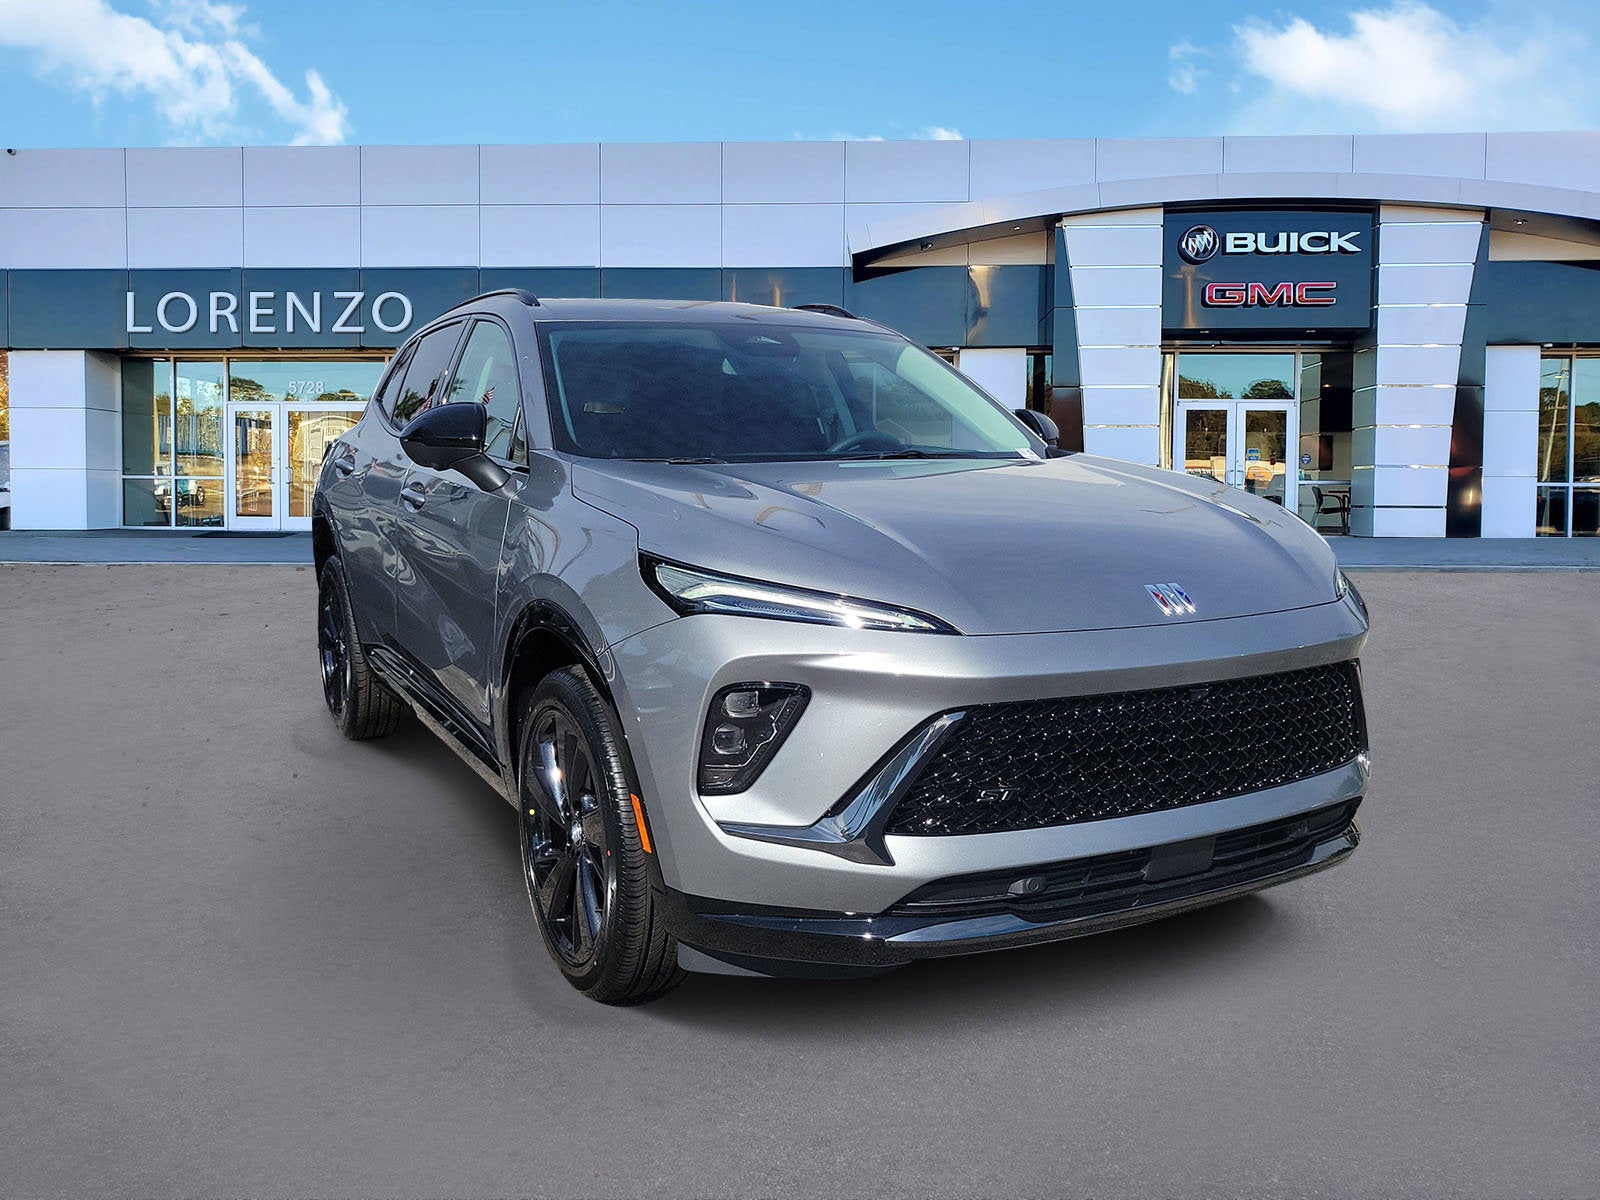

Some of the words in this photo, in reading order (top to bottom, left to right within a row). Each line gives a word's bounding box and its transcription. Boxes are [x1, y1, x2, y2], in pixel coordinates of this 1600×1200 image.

[1226, 231, 1362, 253] BUICK
[1205, 281, 1337, 306] GMC
[126, 291, 413, 333] LORENZO
[288, 380, 325, 394] 5728
